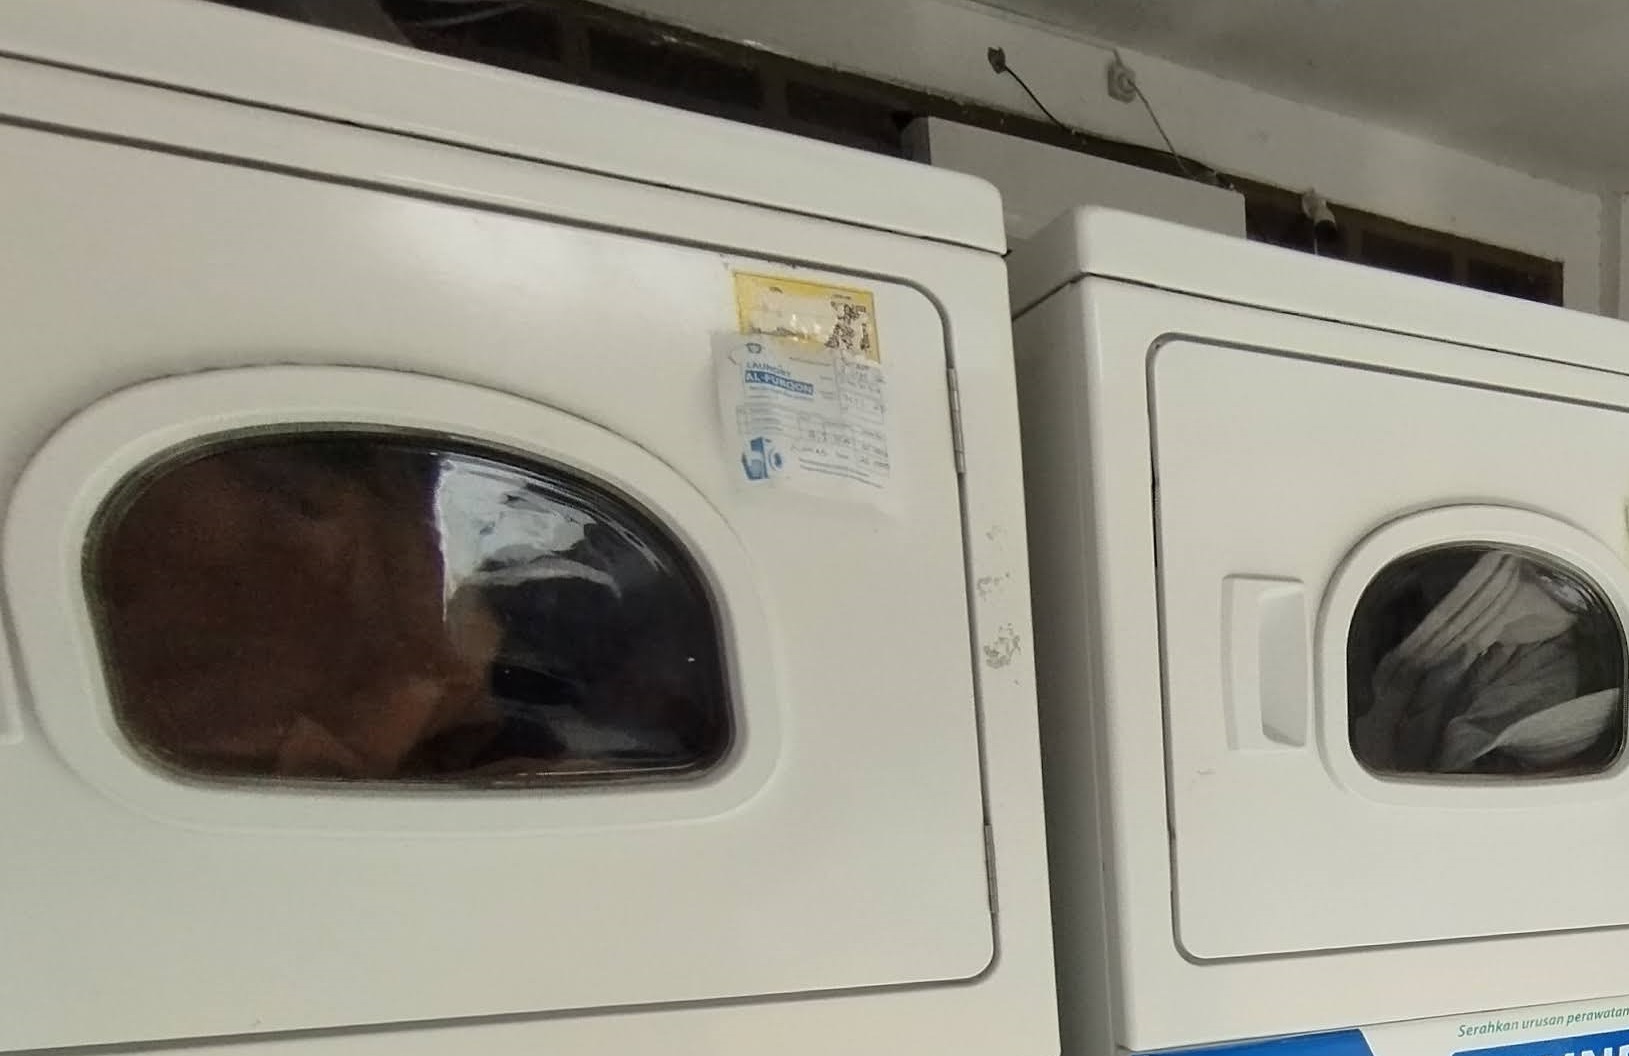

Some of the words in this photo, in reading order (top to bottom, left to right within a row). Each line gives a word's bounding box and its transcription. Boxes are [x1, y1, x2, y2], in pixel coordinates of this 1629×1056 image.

[1457, 1019, 1519, 1038] Serahkan
[1522, 1014, 1564, 1030] urusan
[1566, 1005, 1629, 1027] perawatan
